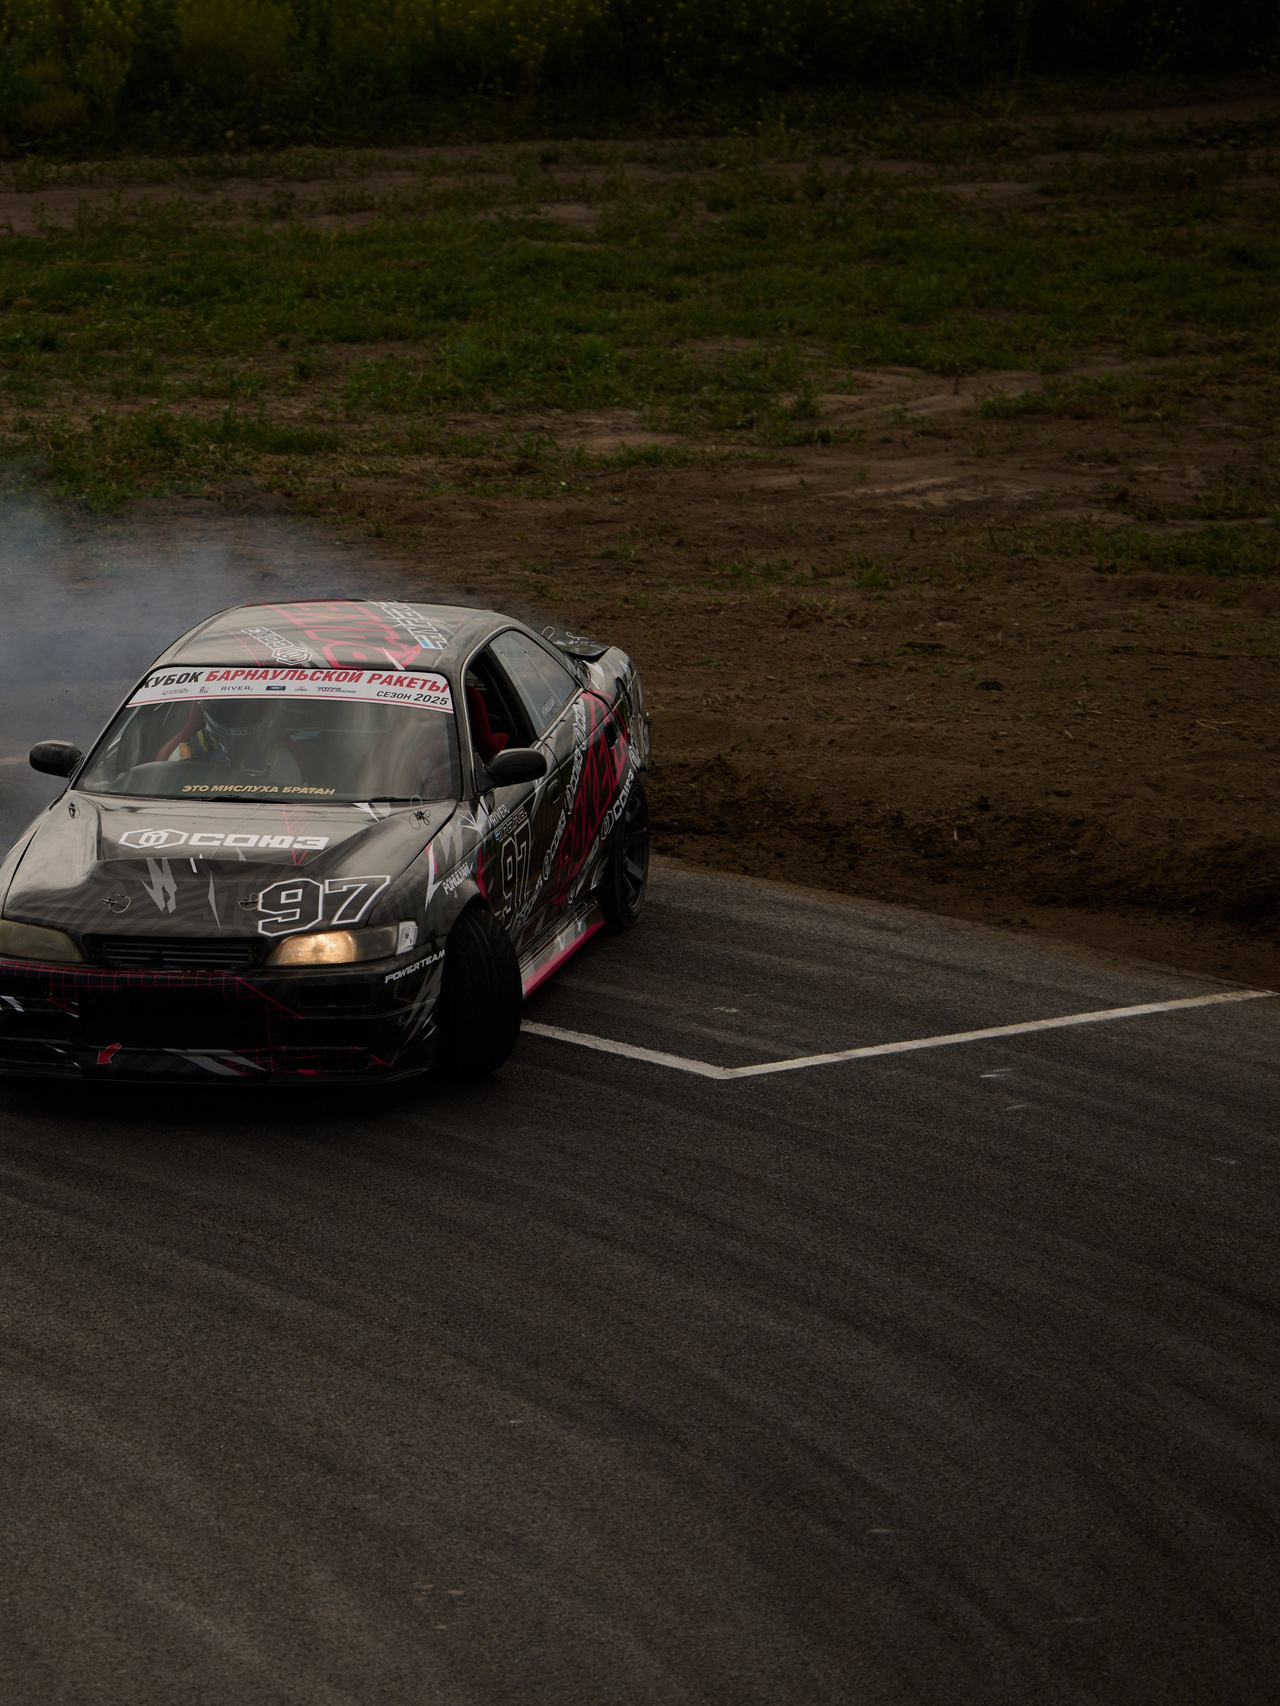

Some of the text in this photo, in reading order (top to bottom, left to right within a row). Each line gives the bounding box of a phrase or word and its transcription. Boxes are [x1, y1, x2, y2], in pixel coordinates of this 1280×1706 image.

[142, 671, 203, 689] КУБОК
[205, 669, 364, 683] БАРНАУЛЬСКОЙ
[367, 673, 449, 694] РАКЕТЫ
[376, 690, 449, 706] СЕЗОН 2025
[211, 785, 279, 793] МИСЛУХА
[282, 786, 336, 796] БРАТАН
[189, 833, 329, 850] СОЮЗ
[257, 875, 391, 937] 97
